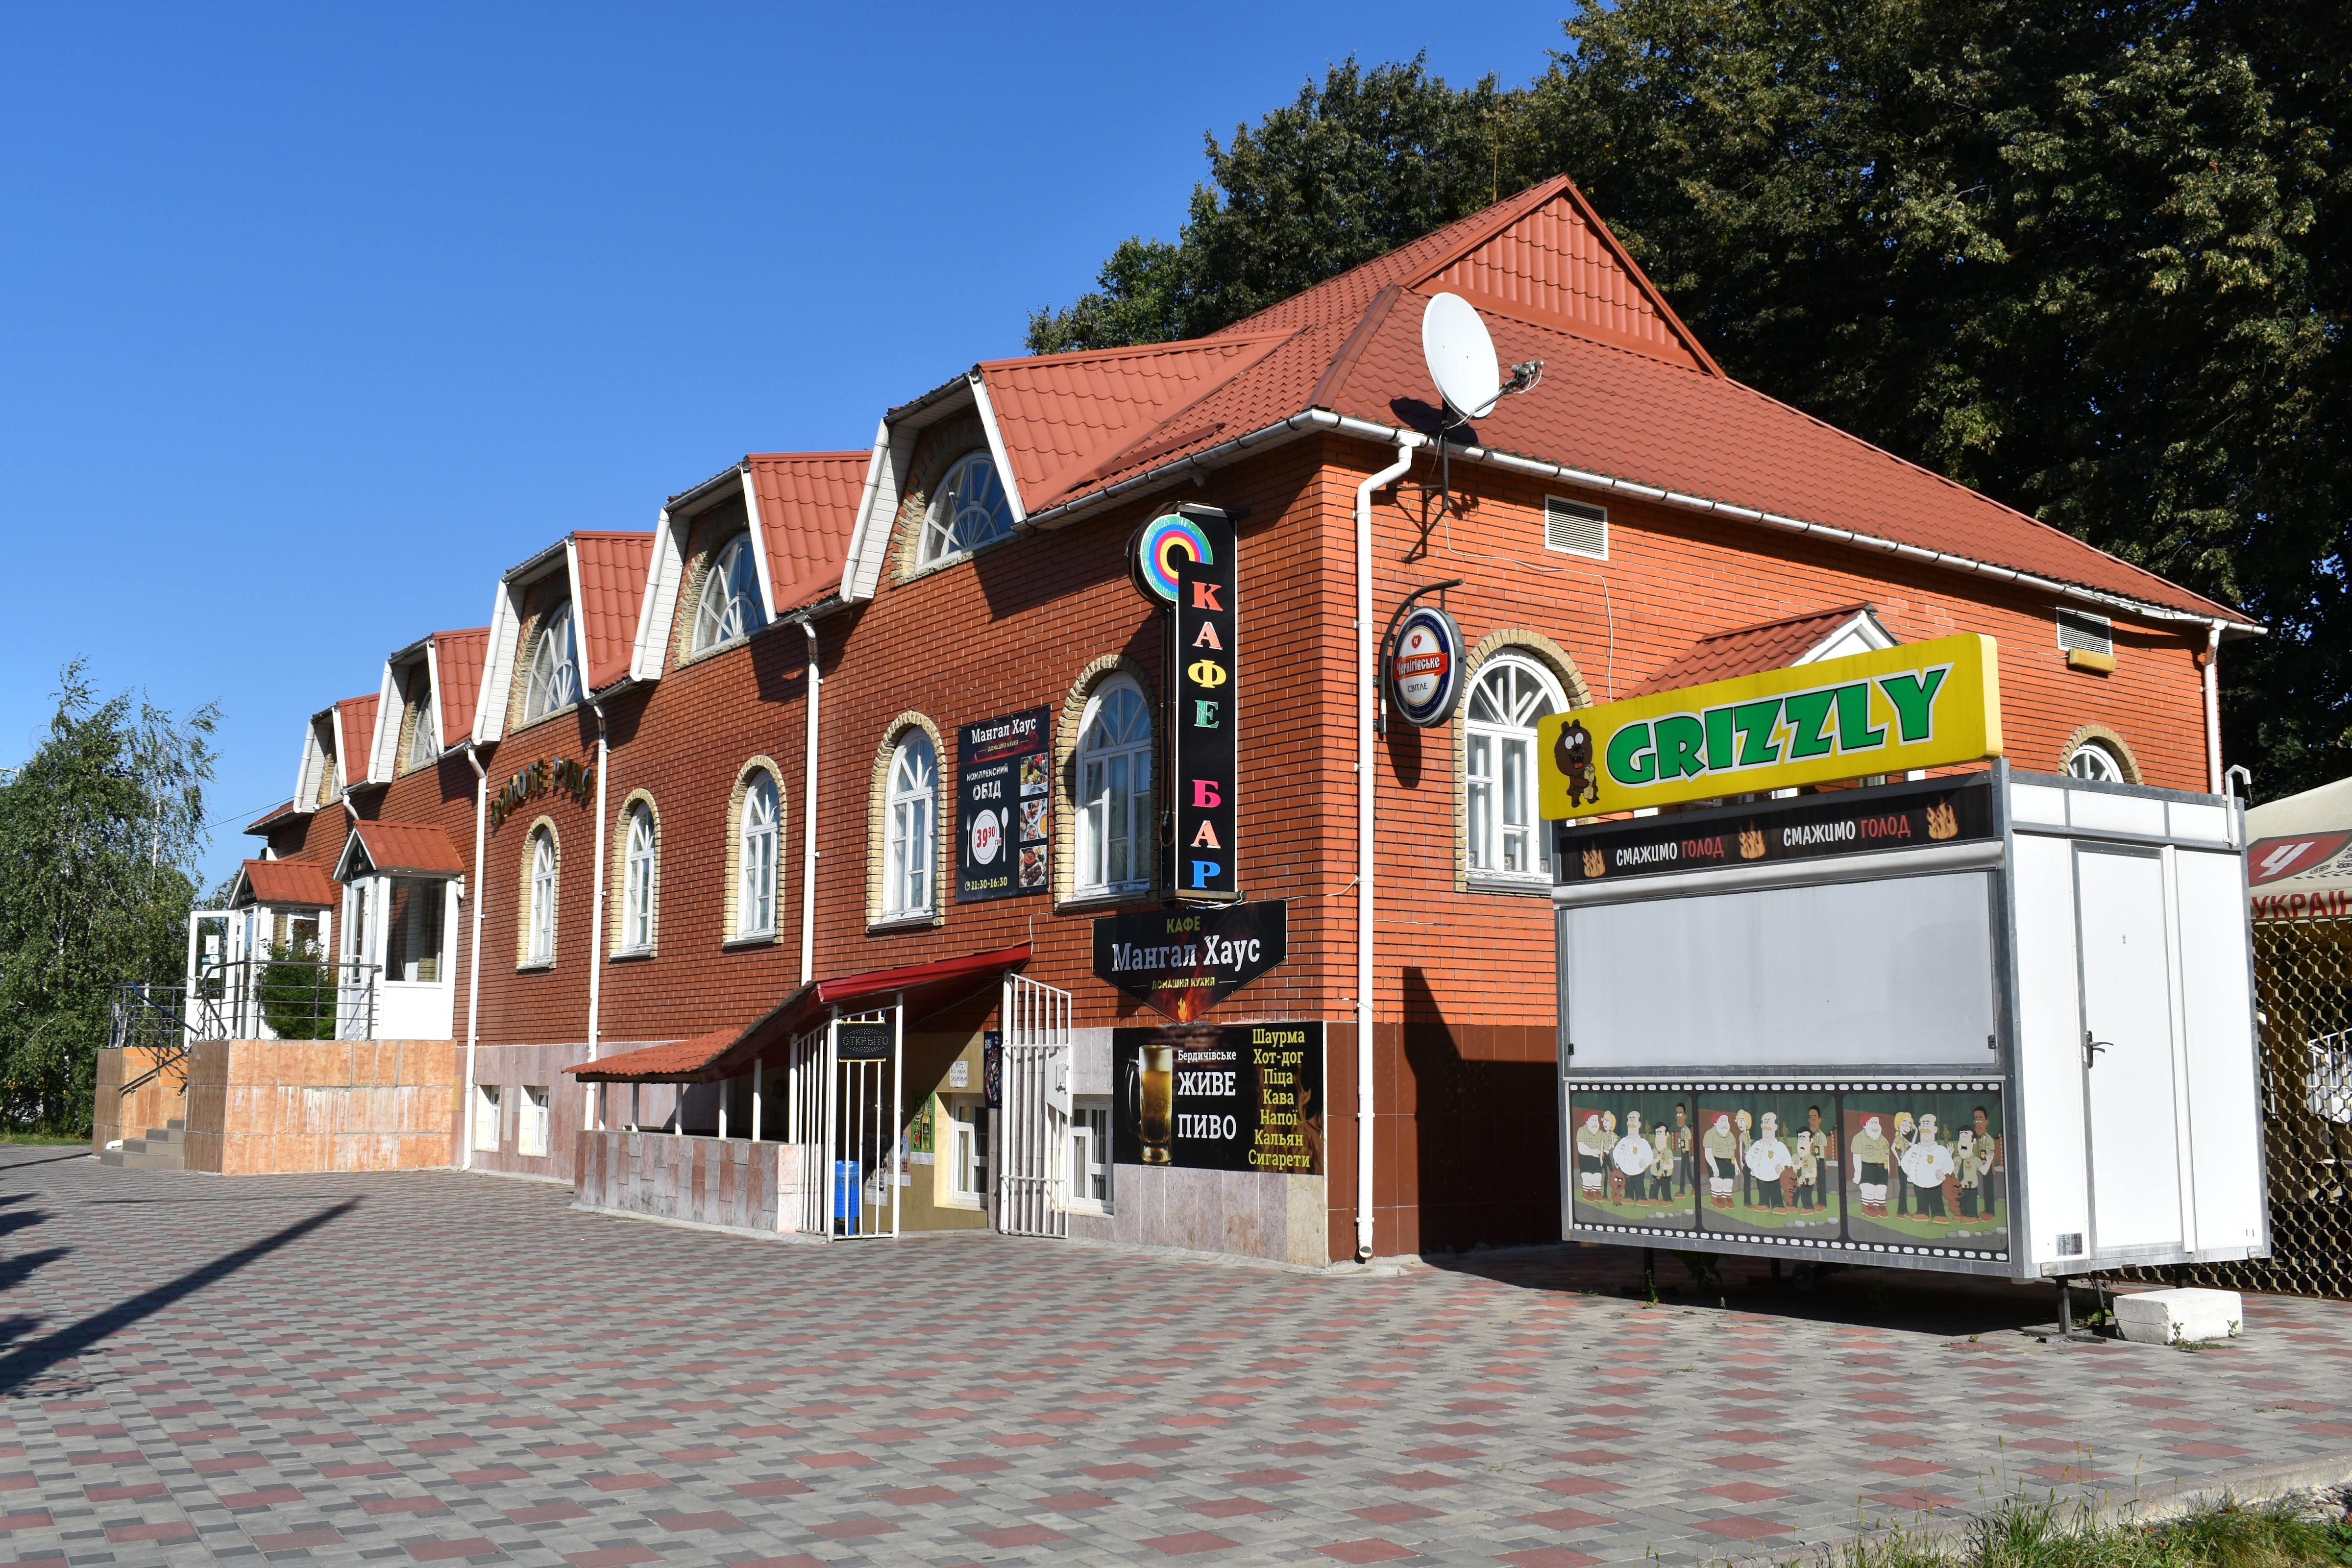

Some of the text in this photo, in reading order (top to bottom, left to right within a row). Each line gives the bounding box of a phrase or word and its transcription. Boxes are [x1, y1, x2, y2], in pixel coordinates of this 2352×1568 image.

[1188, 581, 1226, 729] КАФЕ
[1408, 683, 1428, 692] СВІТЛЕ
[1432, 684, 1445, 705] TRADITIONS
[972, 718, 1036, 744] Мангал Хаус
[1605, 662, 1954, 788] GRIZZLY
[966, 763, 1008, 782] КОМПЛЕКСНИЙ
[973, 780, 1001, 801] ОБІД
[1190, 780, 1222, 888] БАР
[1783, 814, 1911, 847] СМАЖИМО ГОЛОД
[1615, 836, 1724, 867] СМАЖИМО ГОЛОД
[971, 876, 1007, 890] 11:30-16:30
[1166, 916, 1200, 933] КАФЕ
[1112, 934, 1260, 972] Мангал Хаус
[1152, 977, 1215, 990] ДОМАШНЯ КУХНЯ
[843, 1036, 888, 1045] ОТКРЫТО
[1252, 1029, 1305, 1048] Шаурма
[1177, 1050, 1237, 1062] Бердичівське
[1253, 1049, 1303, 1067] Хот-дог
[1177, 1072, 1236, 1096] ЖИВЕ
[1264, 1069, 1293, 1087] Піца
[1263, 1089, 1294, 1105] Кава
[1177, 1114, 1237, 1140] ПИВО
[1260, 1109, 1298, 1126] Напої
[1254, 1129, 1303, 1147] Кальян
[1248, 1149, 1310, 1170] Сигарети
